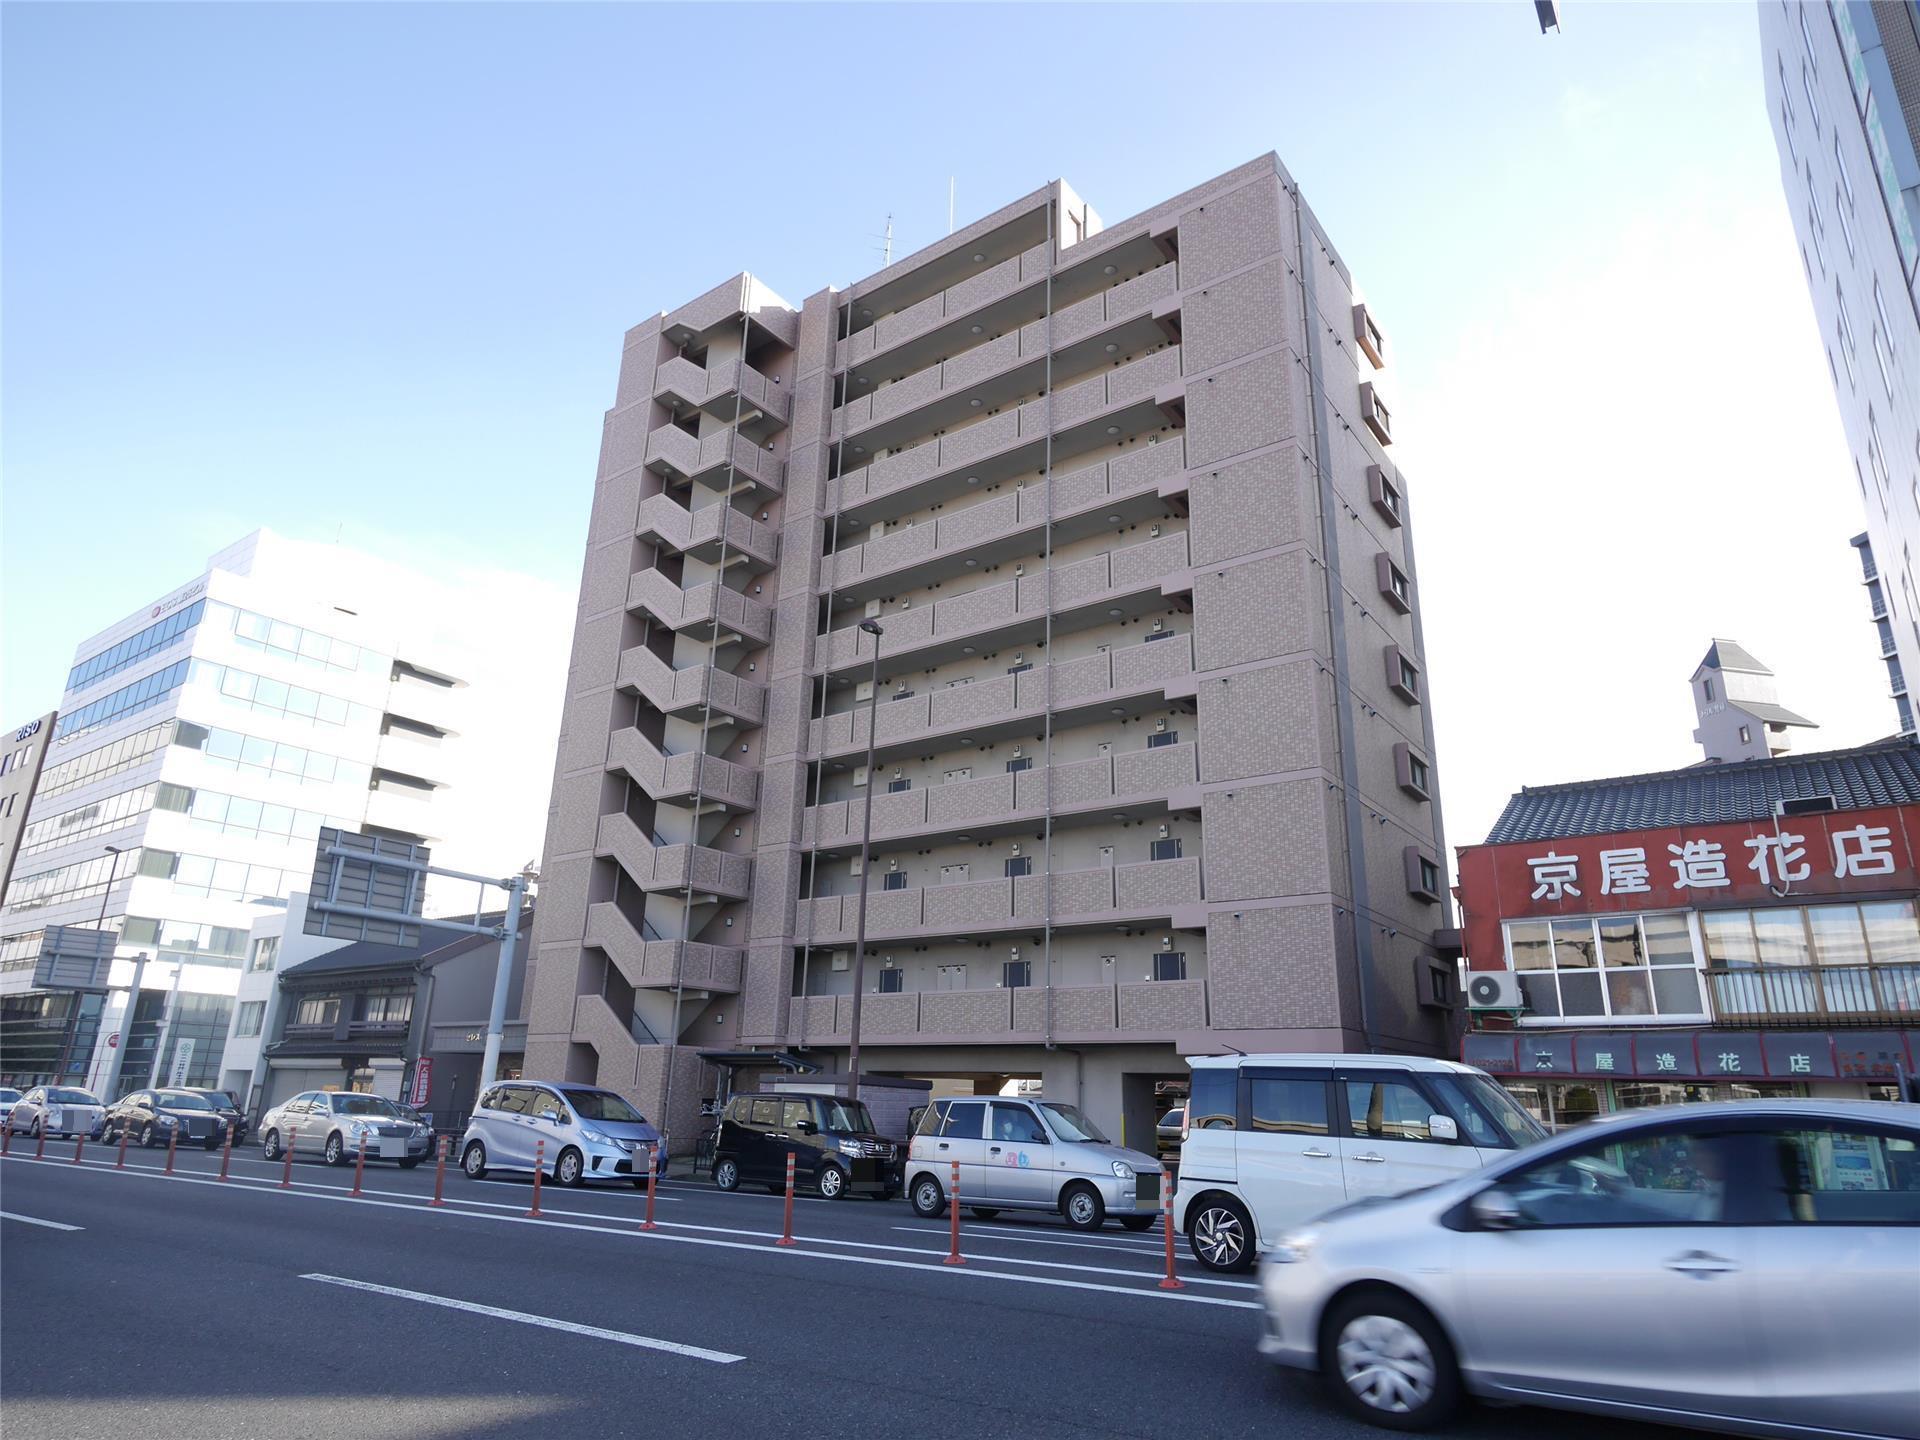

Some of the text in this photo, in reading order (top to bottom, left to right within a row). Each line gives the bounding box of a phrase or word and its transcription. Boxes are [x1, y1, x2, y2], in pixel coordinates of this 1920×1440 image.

[1526, 823, 1896, 901] 京屋造花店
